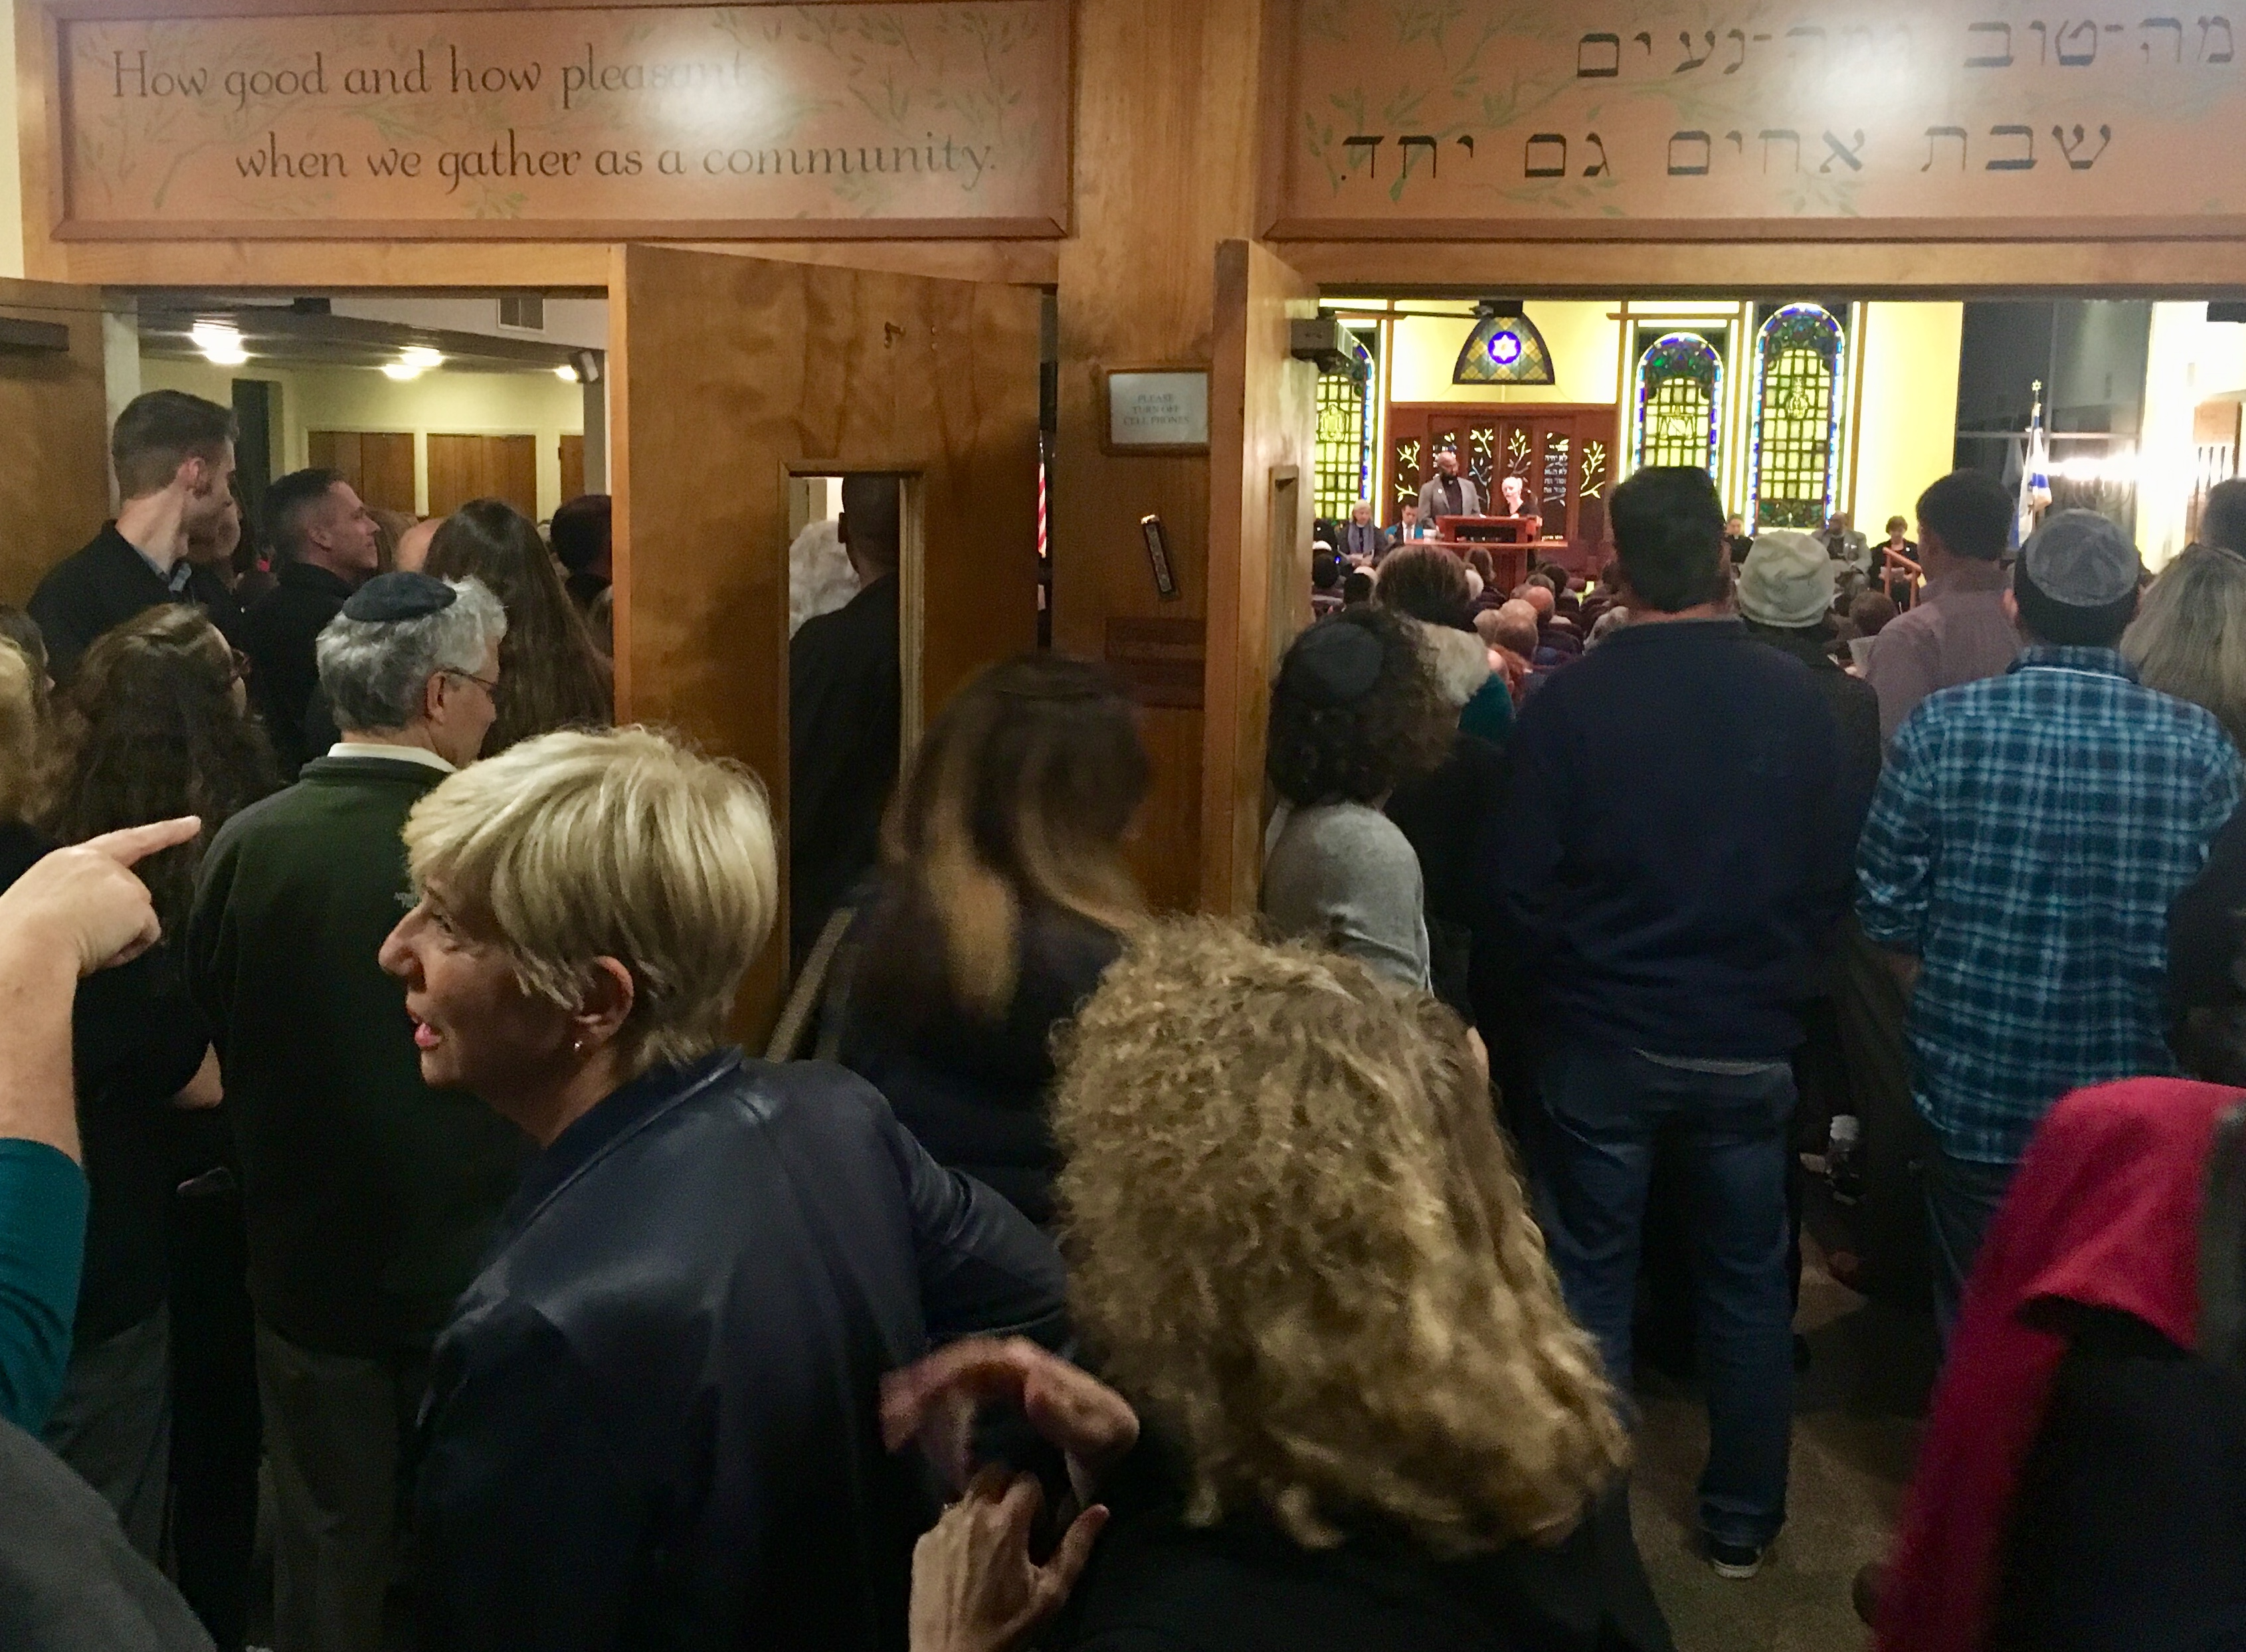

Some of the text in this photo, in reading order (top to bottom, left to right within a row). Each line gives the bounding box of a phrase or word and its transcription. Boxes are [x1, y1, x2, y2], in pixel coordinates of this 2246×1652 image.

[113, 50, 209, 98] How
[224, 51, 329, 112] good
[344, 49, 432, 95] and
[449, 45, 541, 94] how
[236, 128, 996, 195] when we gather as a community.
[1341, 124, 2111, 180] שבת אחים גם יחד.
[1137, 393, 1174, 403] PLEASE
[1150, 415, 1190, 424] PHONES
